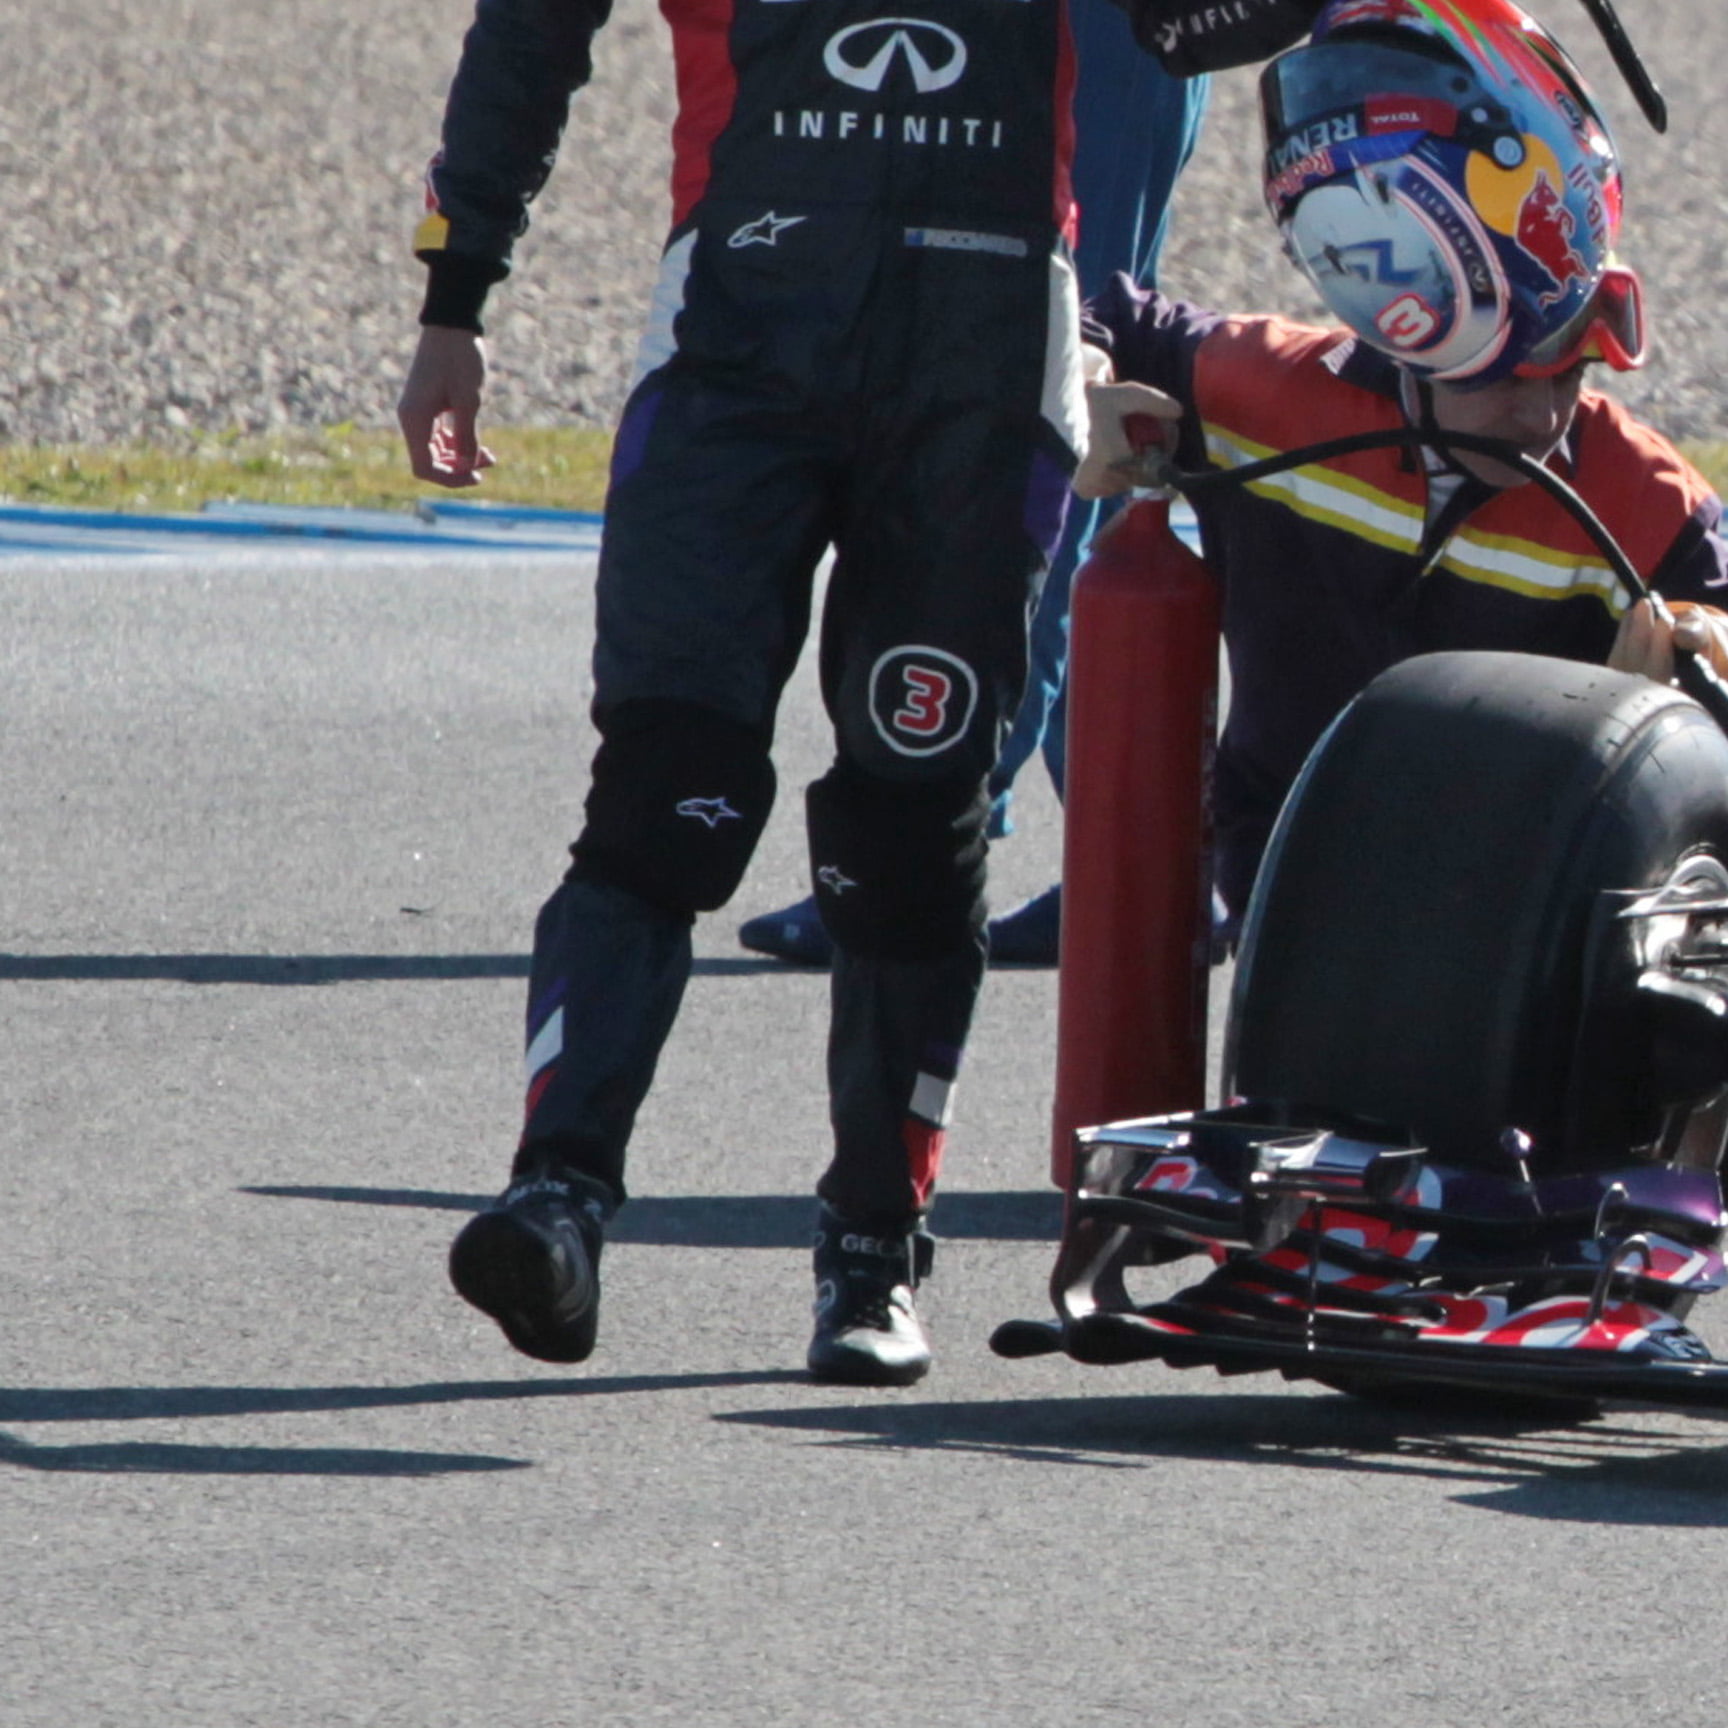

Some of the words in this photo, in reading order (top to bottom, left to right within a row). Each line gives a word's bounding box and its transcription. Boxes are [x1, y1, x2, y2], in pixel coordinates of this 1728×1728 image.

[773, 110, 1003, 148] INFINITI
[1377, 294, 1438, 349] 3
[893, 665, 951, 735] 3
